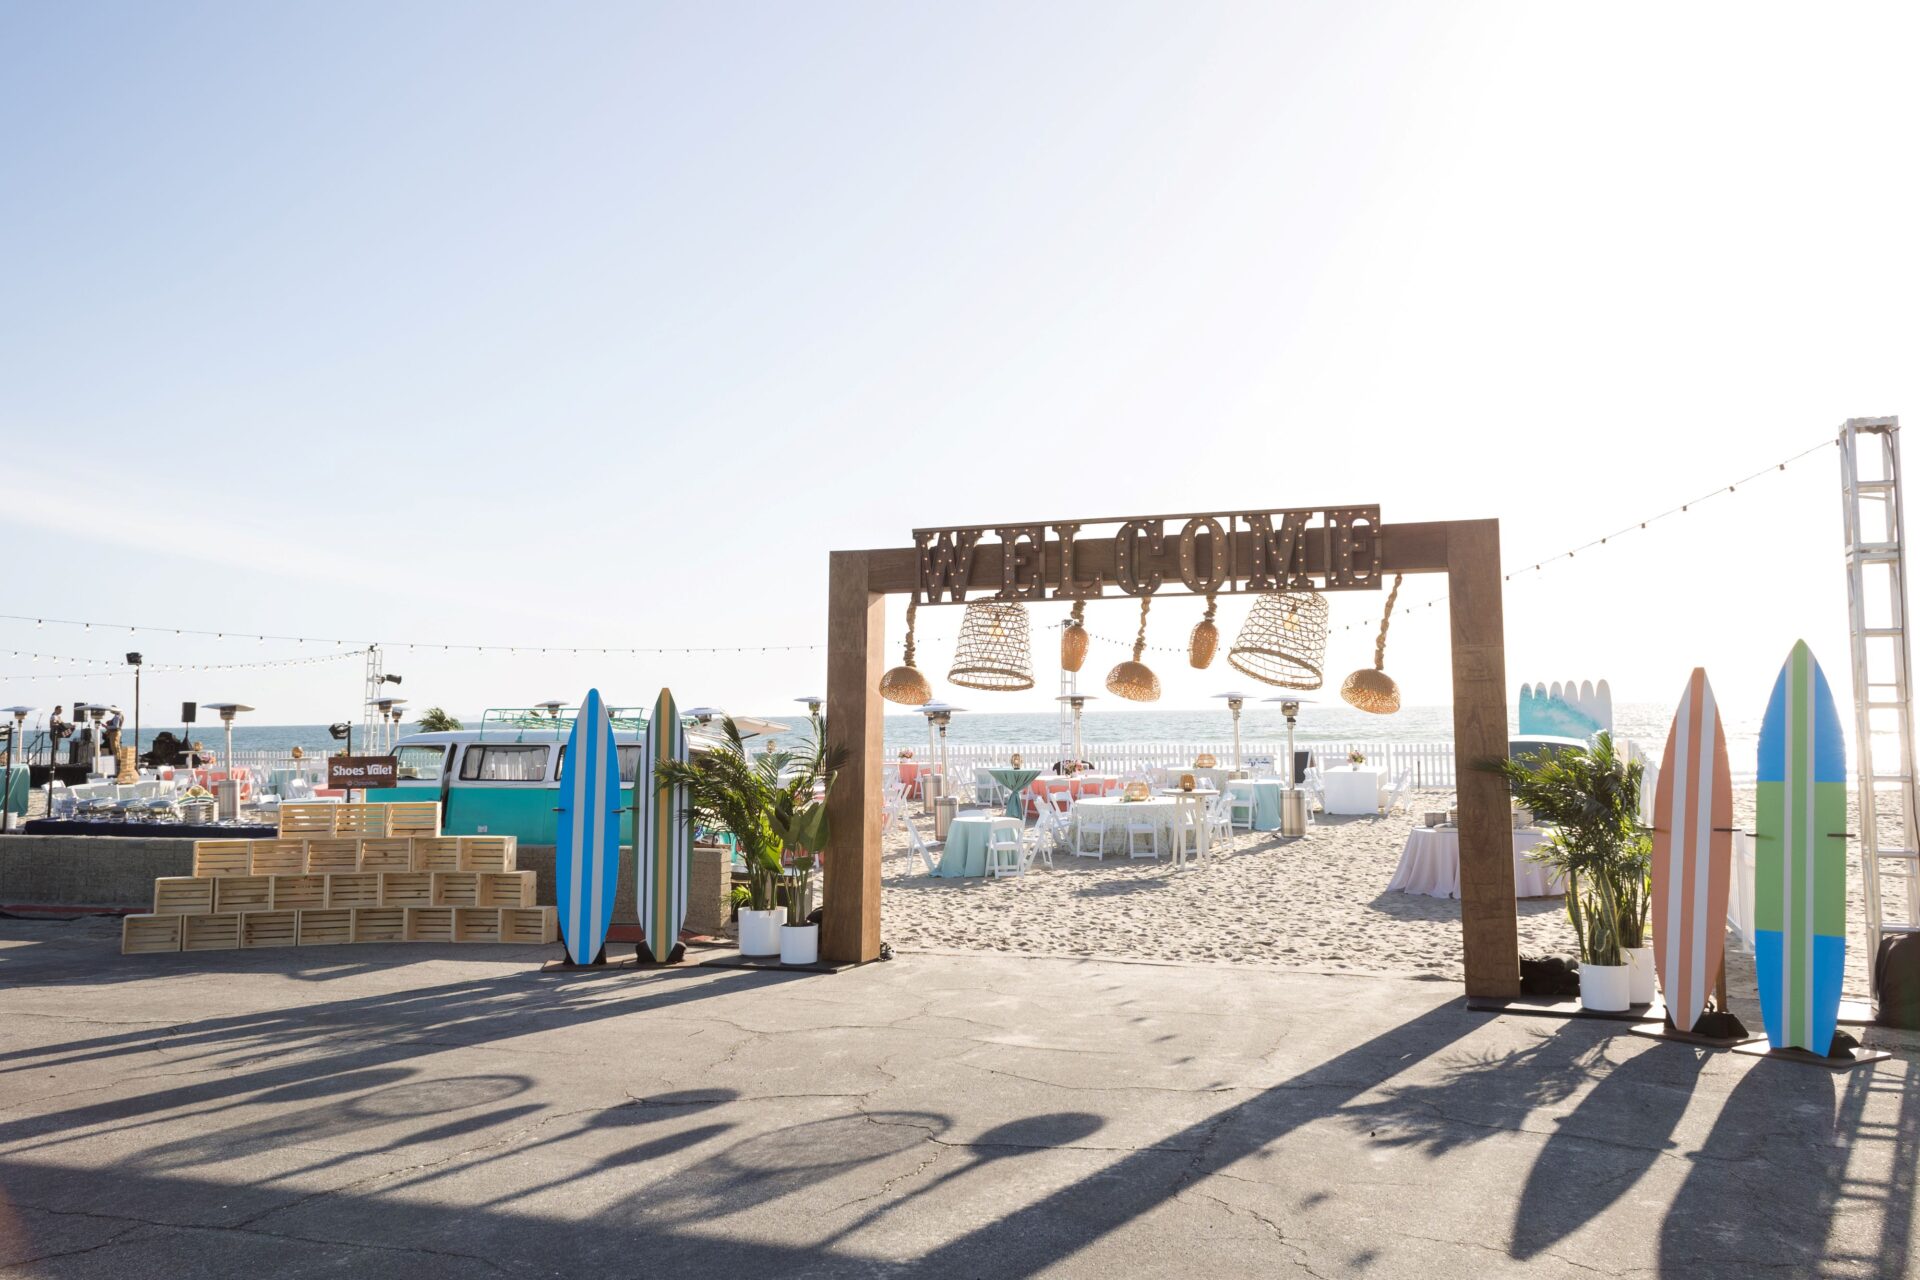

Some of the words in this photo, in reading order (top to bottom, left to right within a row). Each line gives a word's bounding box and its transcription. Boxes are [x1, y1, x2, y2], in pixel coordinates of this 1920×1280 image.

[914, 507, 1382, 603] WELCOME
[332, 765, 365, 776] Shoes
[366, 764, 393, 775] Valet
